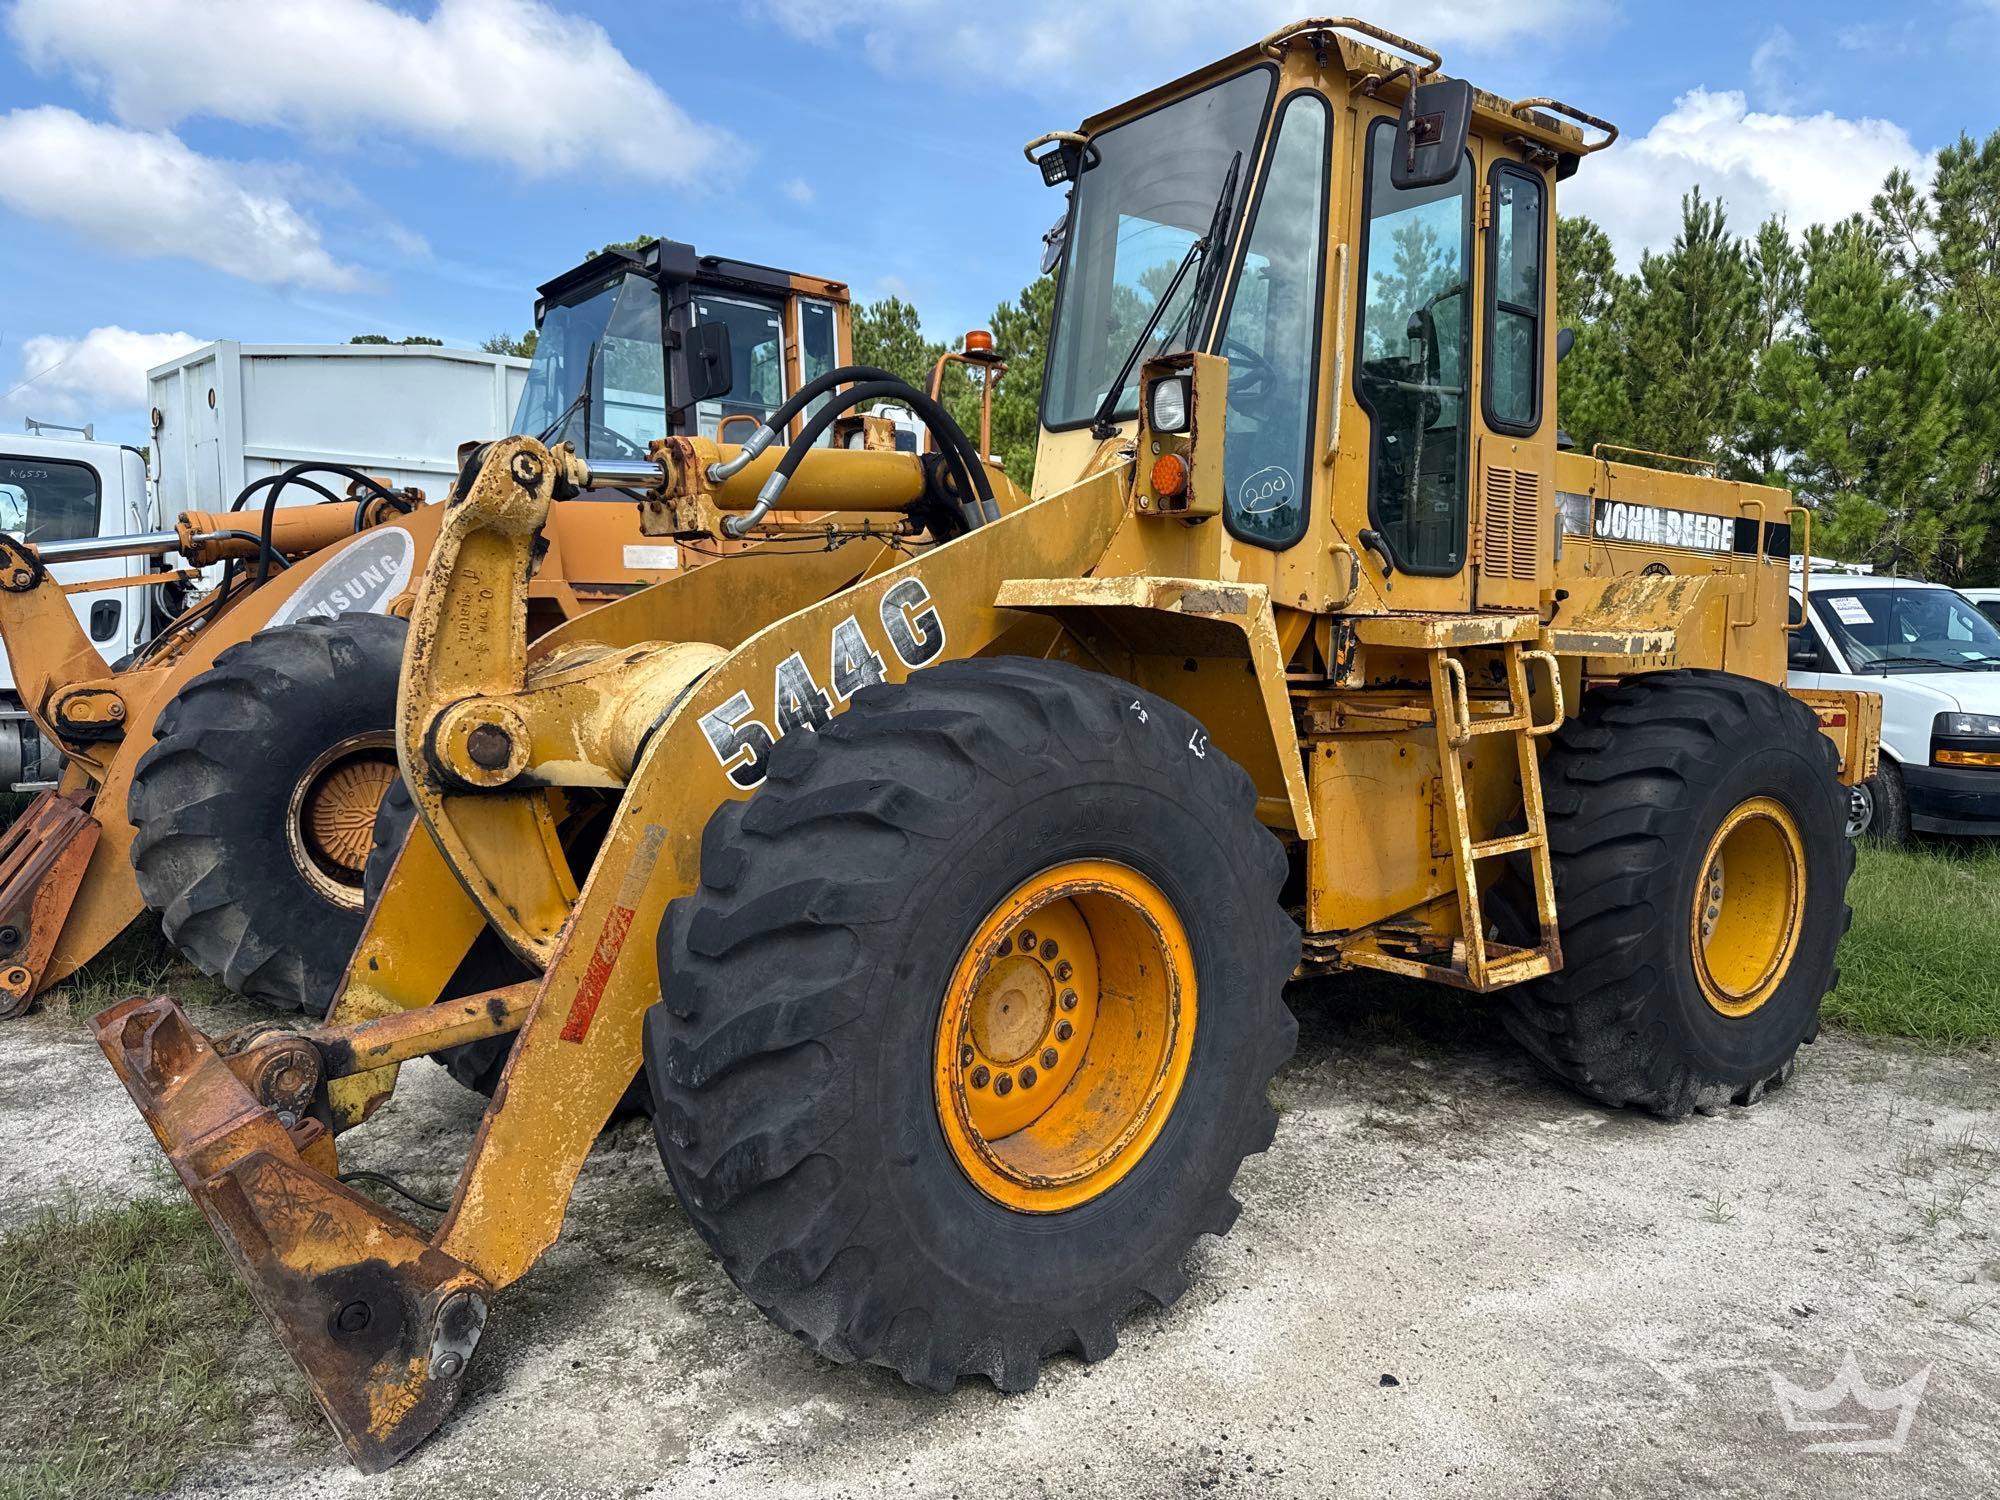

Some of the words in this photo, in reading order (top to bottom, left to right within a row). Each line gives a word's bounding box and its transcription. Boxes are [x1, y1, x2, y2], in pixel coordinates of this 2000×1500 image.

[1245, 475, 1286, 509] 200
[1594, 501, 1660, 544] JOHN
[1665, 510, 1734, 551] DEERE
[304, 554, 401, 621] MSUNG
[696, 576, 946, 791] 544G
